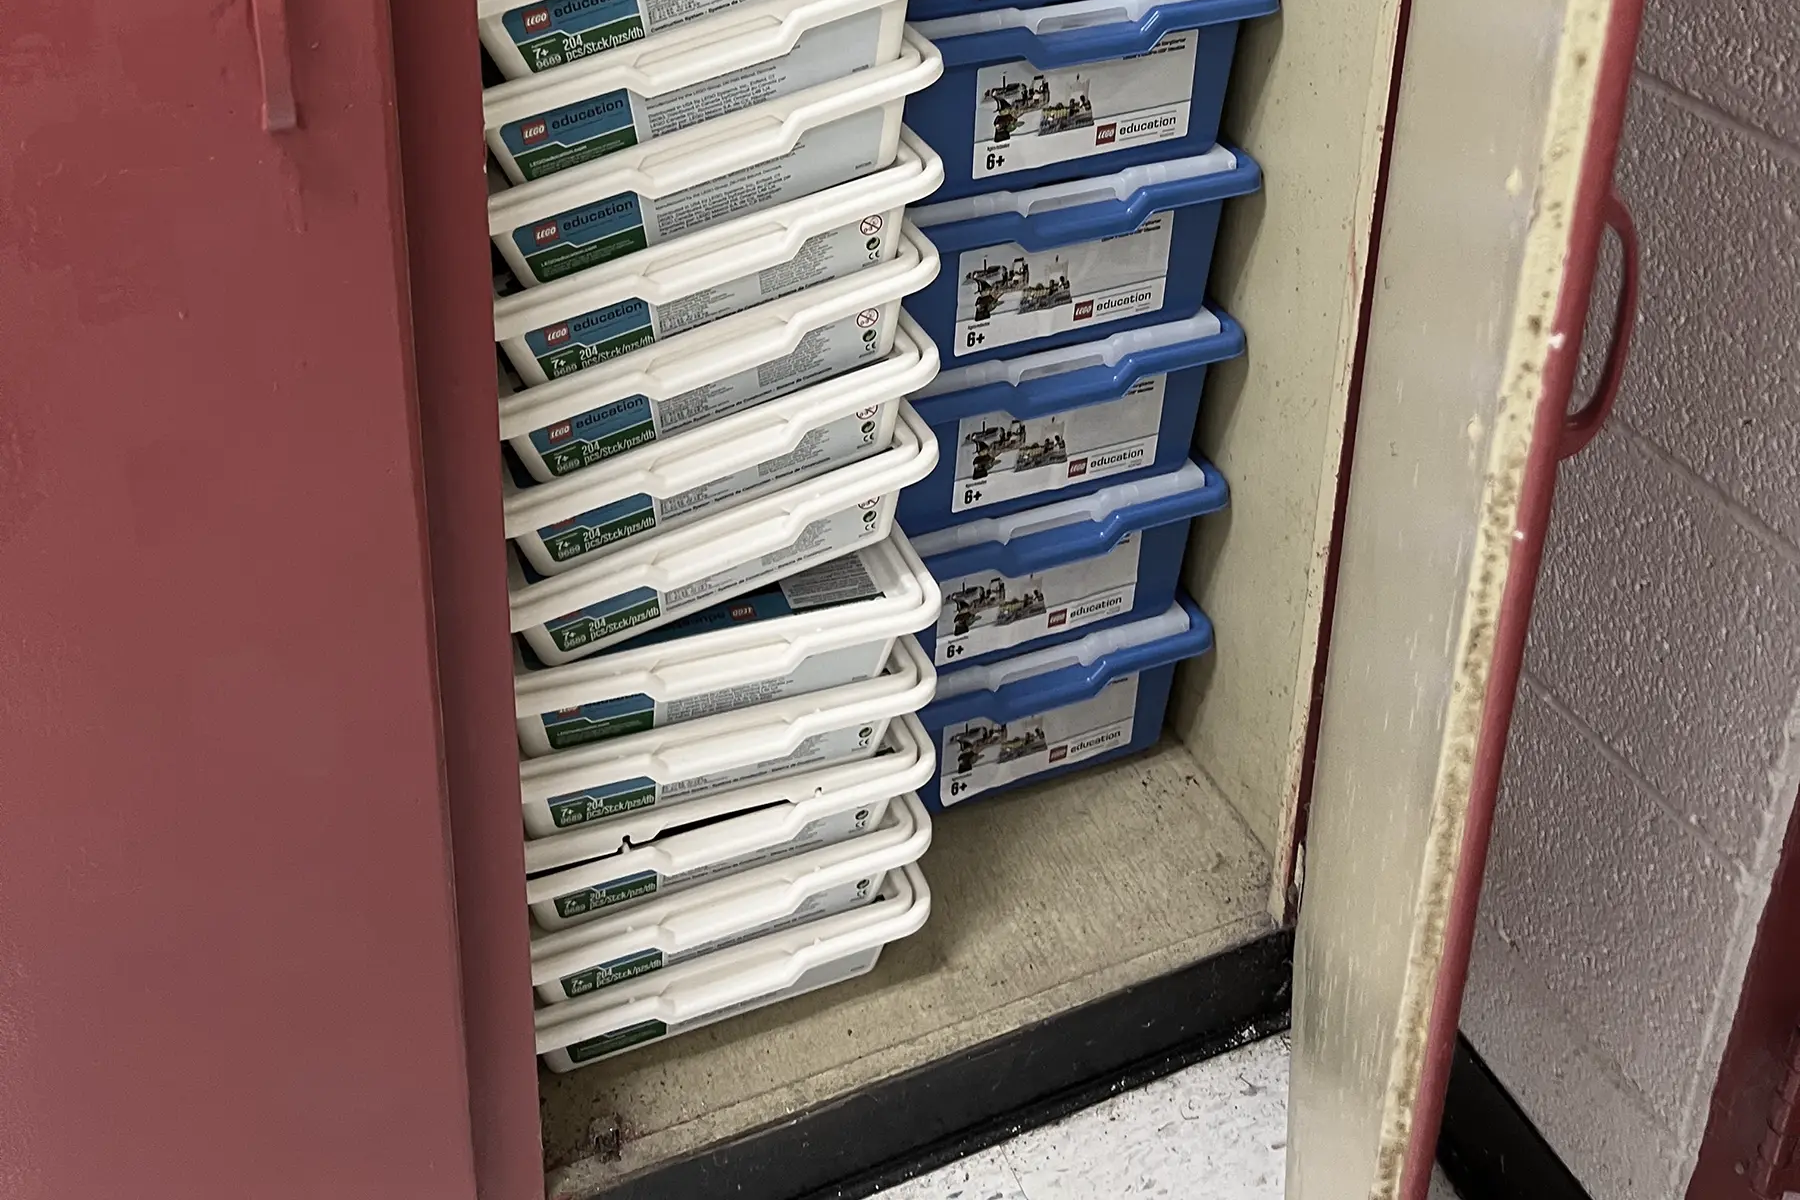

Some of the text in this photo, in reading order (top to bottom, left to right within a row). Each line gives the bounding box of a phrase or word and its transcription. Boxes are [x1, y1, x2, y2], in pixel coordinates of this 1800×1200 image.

[525, 11, 547, 27] LEGO
[562, 34, 583, 50] 204
[566, 27, 643, 63] pcs/Stck/pzs/db
[532, 47, 549, 60] 7+
[523, 99, 624, 139] LEGO education
[1098, 116, 1176, 140] LEGO education
[986, 153, 1005, 171] 6+
[536, 200, 633, 240] LEGO education
[1075, 291, 1152, 316] LEGO education
[547, 302, 642, 341] LEGO education
[966, 331, 985, 347] 6+
[579, 345, 598, 360] 204
[551, 358, 566, 369] 7+
[551, 425, 570, 438] LEGO
[576, 397, 643, 429] education
[581, 440, 600, 455] 204
[554, 454, 569, 465] 7+
[1090, 448, 1144, 468] education
[964, 489, 982, 504] 6+
[582, 528, 601, 542] 204
[556, 540, 570, 551] 7+
[1070, 596, 1122, 618] education
[588, 618, 606, 632] 204
[562, 630, 577, 641] 7+
[947, 644, 964, 658] 6+
[1070, 730, 1121, 753] education
[561, 807, 574, 817] 7+
[586, 799, 604, 811] 204
[590, 889, 606, 901] 204
